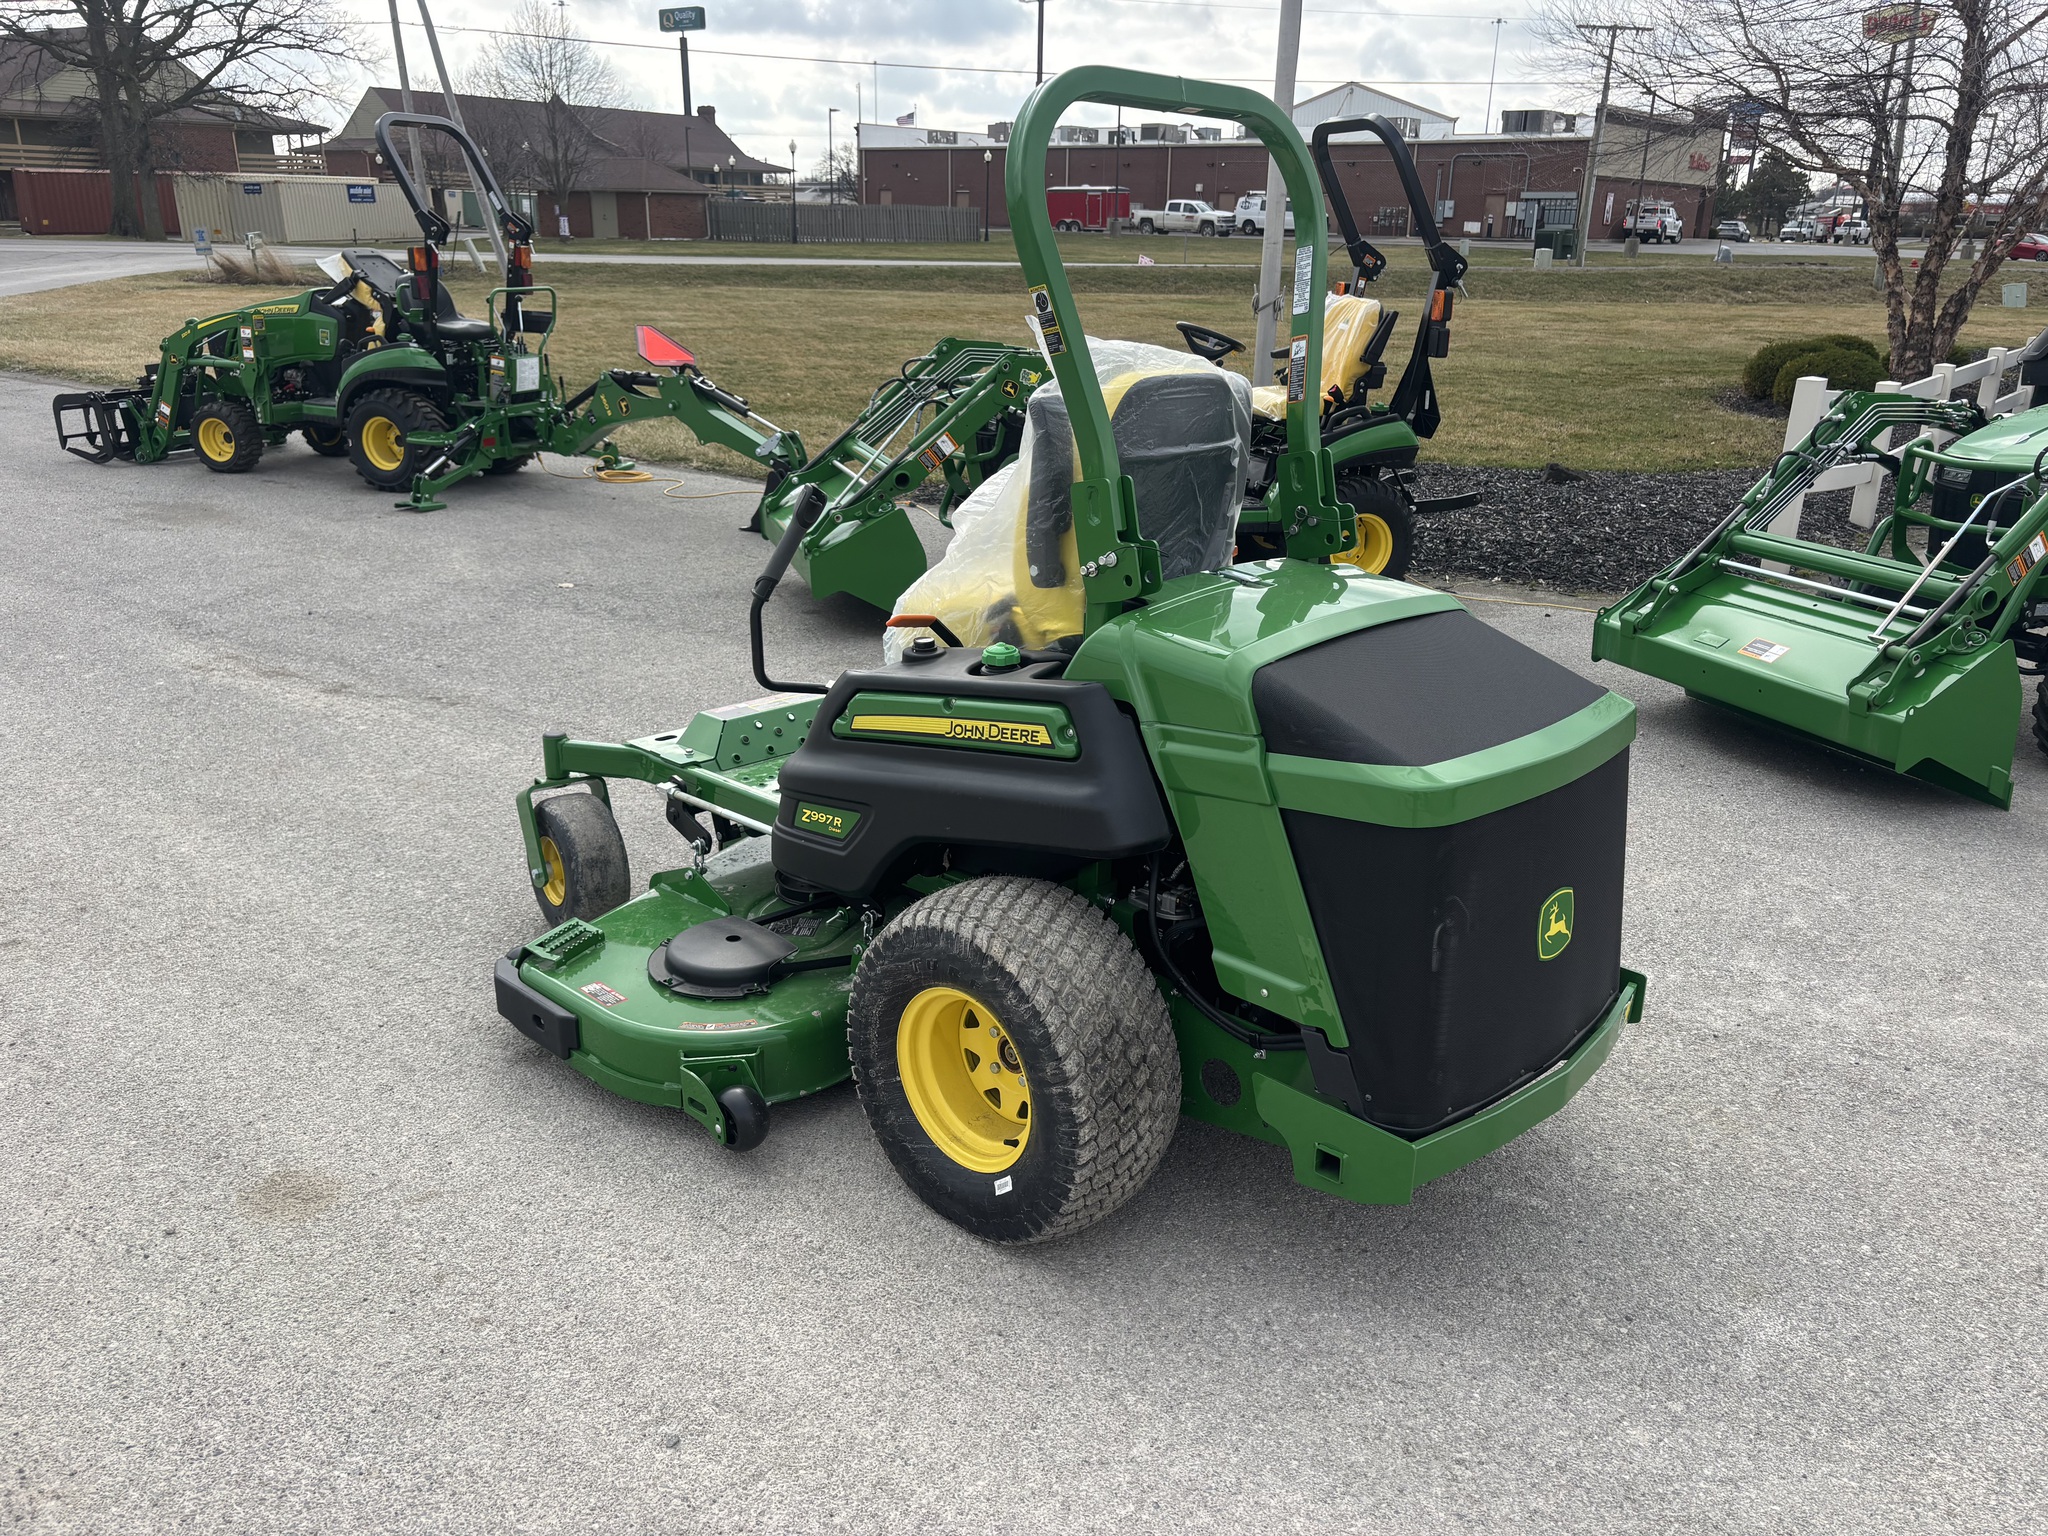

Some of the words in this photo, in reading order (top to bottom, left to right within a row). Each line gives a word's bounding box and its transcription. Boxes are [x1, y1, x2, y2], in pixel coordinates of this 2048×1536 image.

[674, 10, 696, 21] Quality
[945, 721, 985, 740] JOHN
[989, 724, 1040, 743] DEERE
